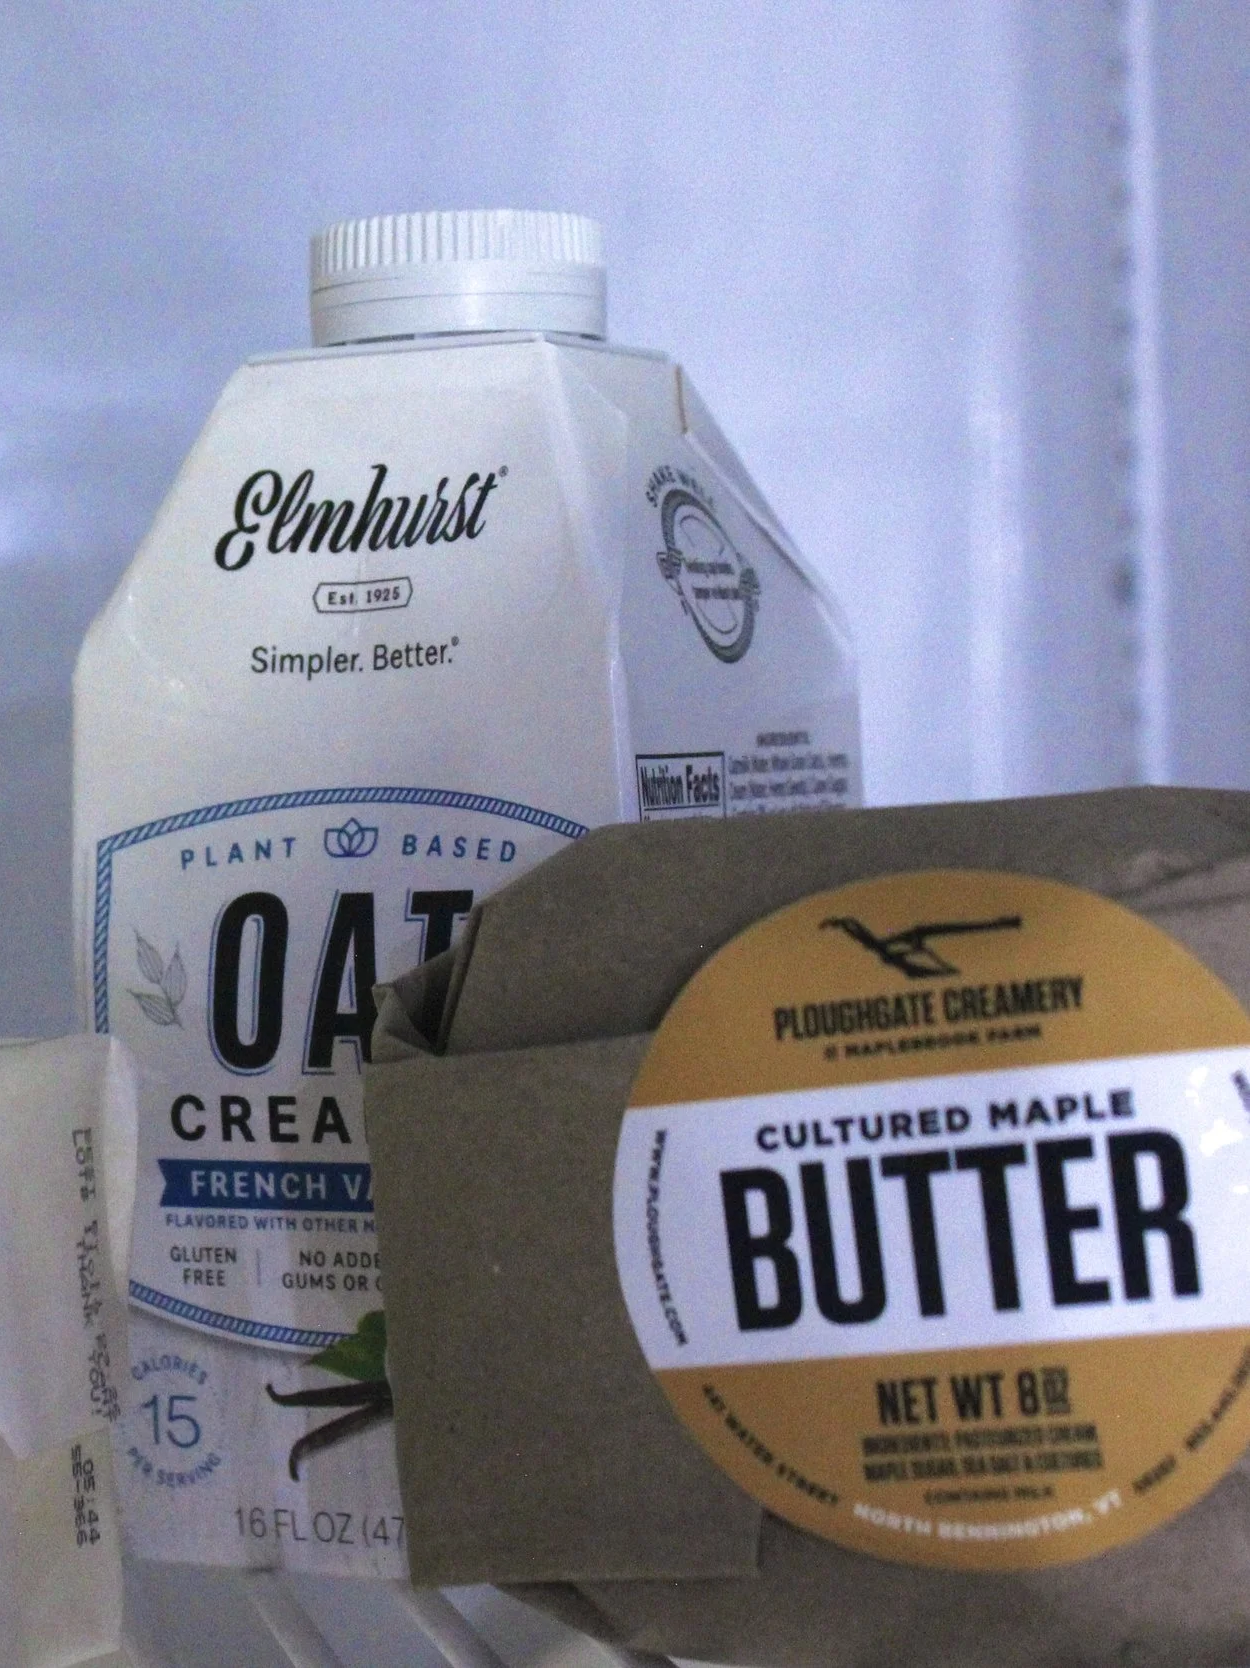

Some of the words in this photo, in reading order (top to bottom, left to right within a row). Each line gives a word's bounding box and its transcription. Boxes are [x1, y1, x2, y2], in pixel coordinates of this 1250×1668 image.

[366, 586, 401, 604] 1925
[251, 646, 364, 681] Simpler.
[639, 765, 684, 805] Nutrition
[685, 763, 720, 803] Facts
[180, 836, 298, 870] PLANT
[402, 833, 517, 864] BASED
[773, 992, 934, 1042] PLOUGHGATE
[942, 975, 1085, 1024] CREAMERY
[170, 1094, 353, 1144] CREA
[755, 1106, 971, 1153] CULTURED
[987, 1088, 1135, 1131] MAPLE
[190, 1170, 327, 1200] FRENCH
[165, 1213, 249, 1230] FLAVORED
[254, 1215, 297, 1231] WITH
[302, 1218, 358, 1234] OTHER
[719, 1126, 1202, 1332] BUTTER
[170, 1246, 237, 1264] GLUTEN
[299, 1251, 326, 1268] NO
[182, 1268, 226, 1287] FREE
[282, 1272, 336, 1290] GUMS
[343, 1274, 369, 1291] OR
[130, 1355, 208, 1385] CALORIES
[876, 1376, 939, 1427] NET
[950, 1370, 1005, 1421] WT
[142, 1394, 201, 1448] 15
[155, 1452, 222, 1488] SERVING
[234, 1505, 267, 1538] 16
[273, 1508, 307, 1541] FL
[312, 1511, 355, 1546] OZ
[852, 1503, 933, 1538] NORTH
